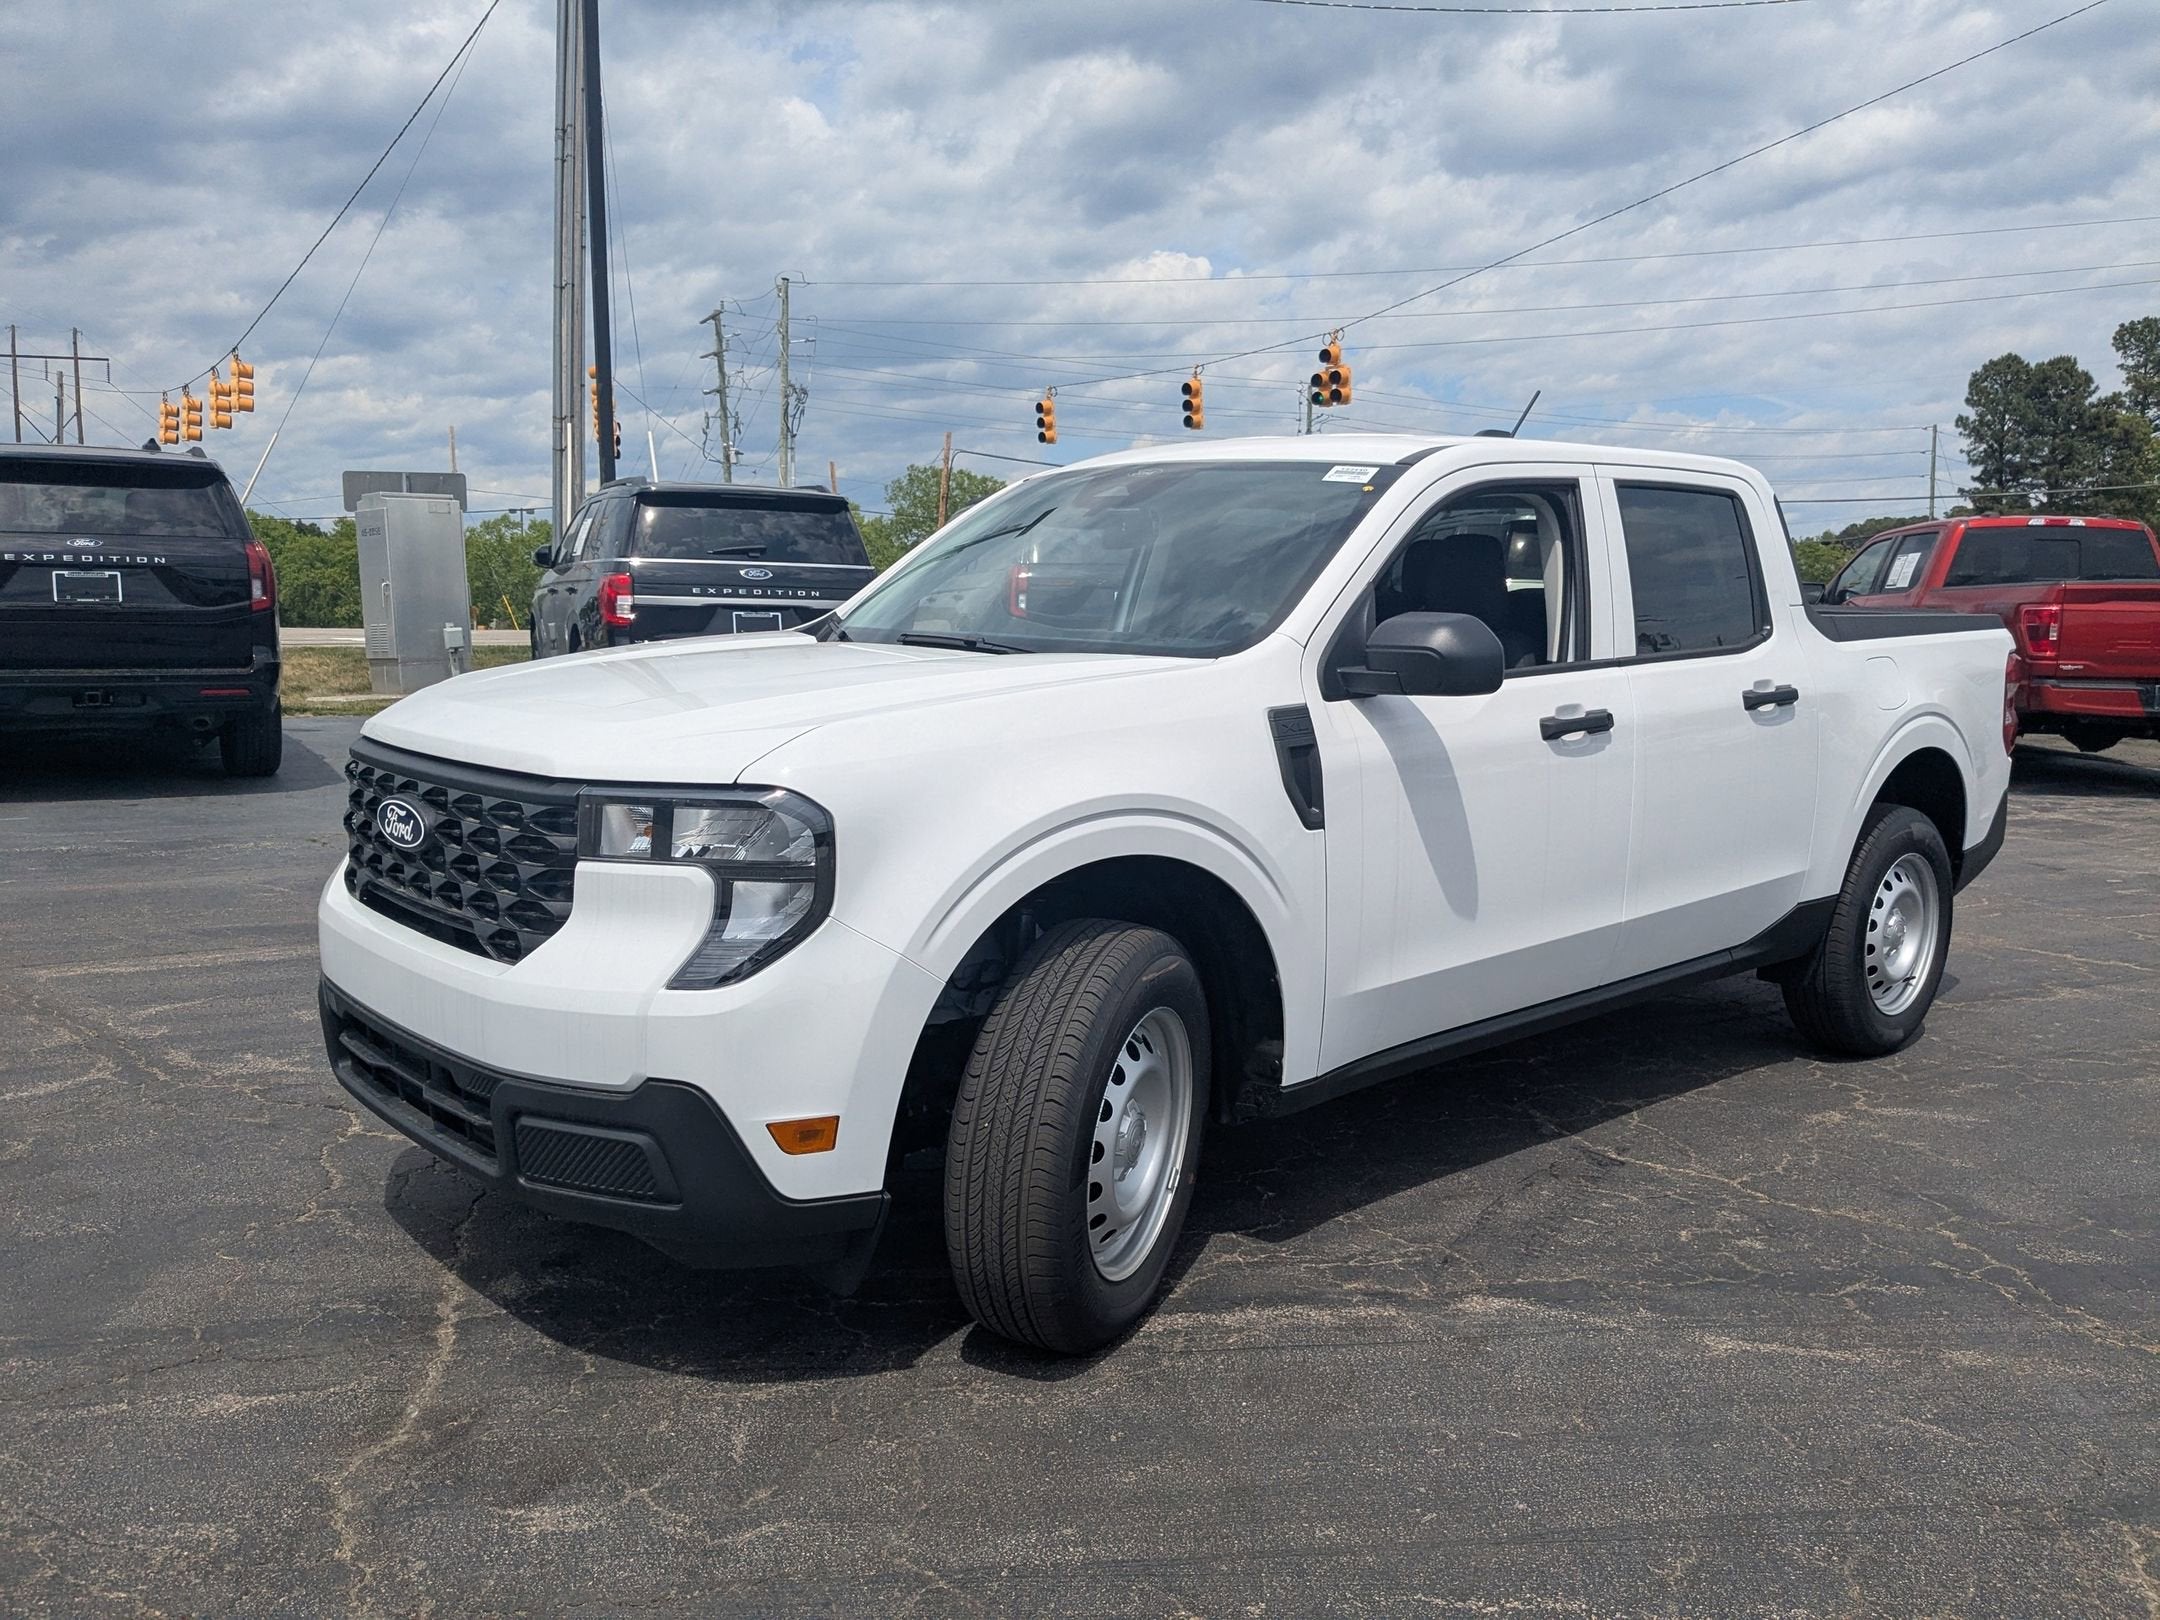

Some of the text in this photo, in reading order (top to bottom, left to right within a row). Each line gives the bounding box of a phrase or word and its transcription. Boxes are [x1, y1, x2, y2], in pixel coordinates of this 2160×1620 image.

[4, 553, 166, 564] EXPEDITION
[692, 587, 821, 597] EXPEDITION
[1280, 722, 1309, 734] XL
[384, 804, 415, 842] Ford
